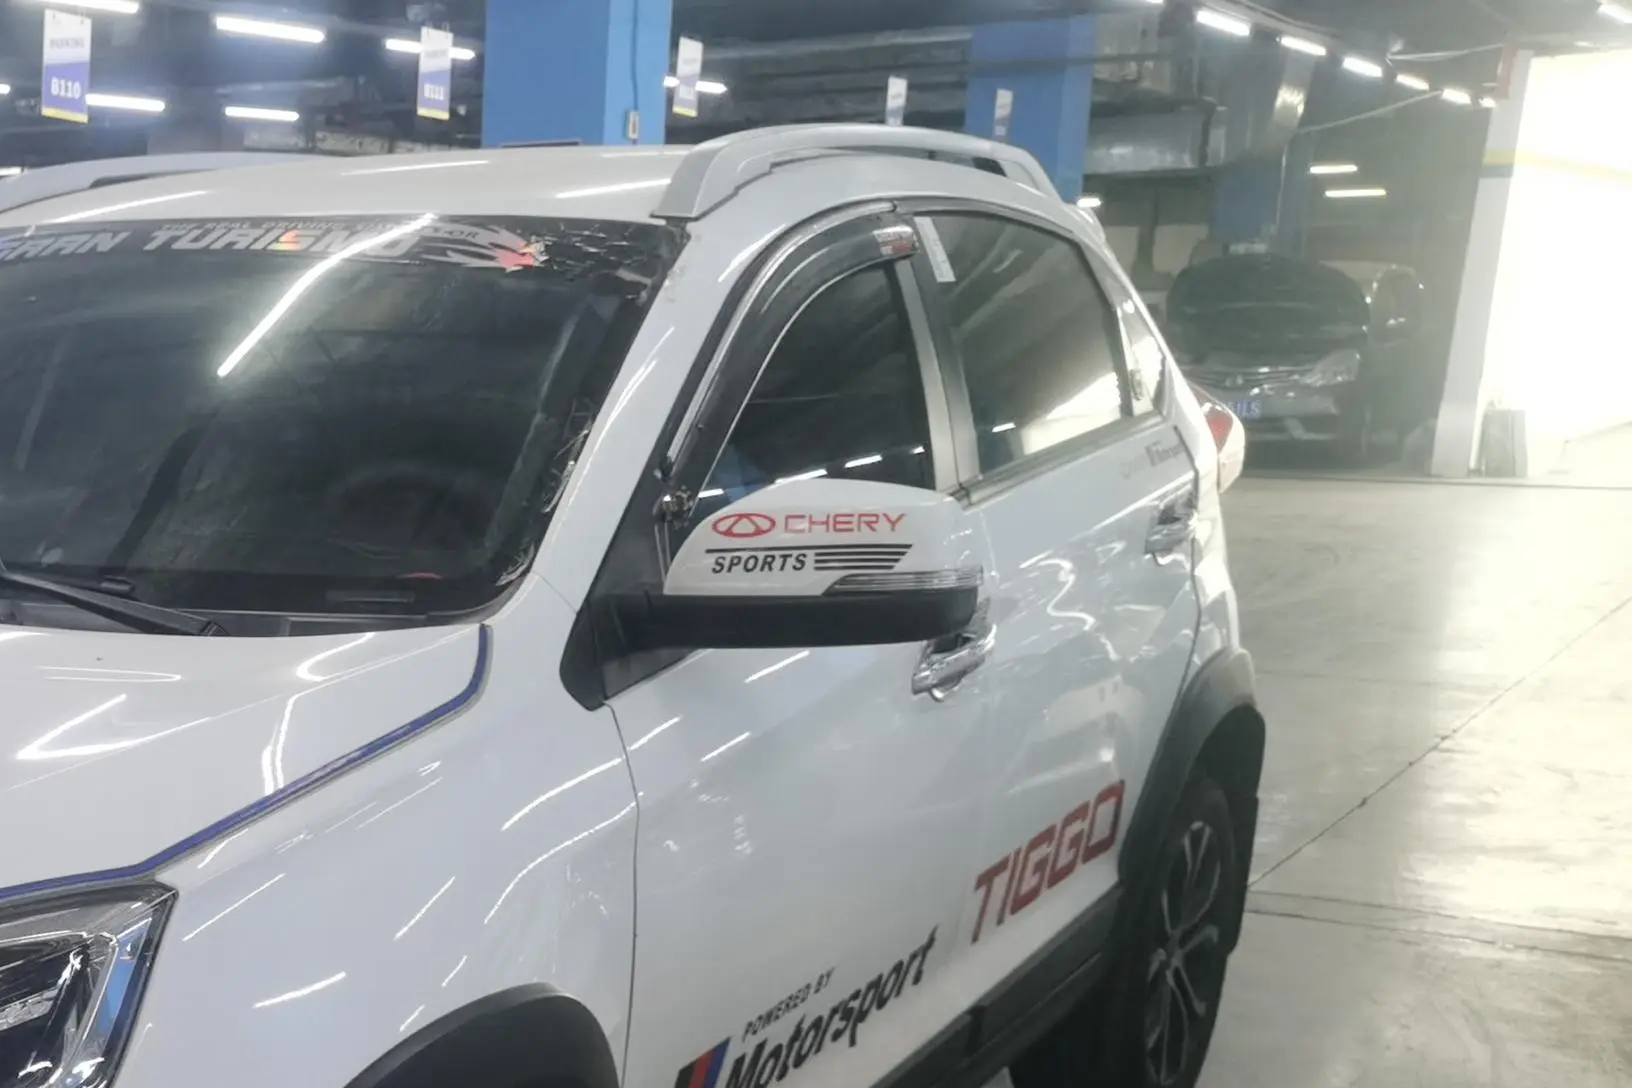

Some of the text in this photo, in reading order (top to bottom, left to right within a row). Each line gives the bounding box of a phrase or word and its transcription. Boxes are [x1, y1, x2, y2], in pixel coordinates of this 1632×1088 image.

[51, 76, 82, 99] B110
[143, 227, 419, 257] TURISMO
[784, 512, 907, 534] CHERY
[711, 552, 808, 575] SPORTS
[970, 778, 1126, 946] TIGGO
[741, 966, 837, 1044] POWERED BY
